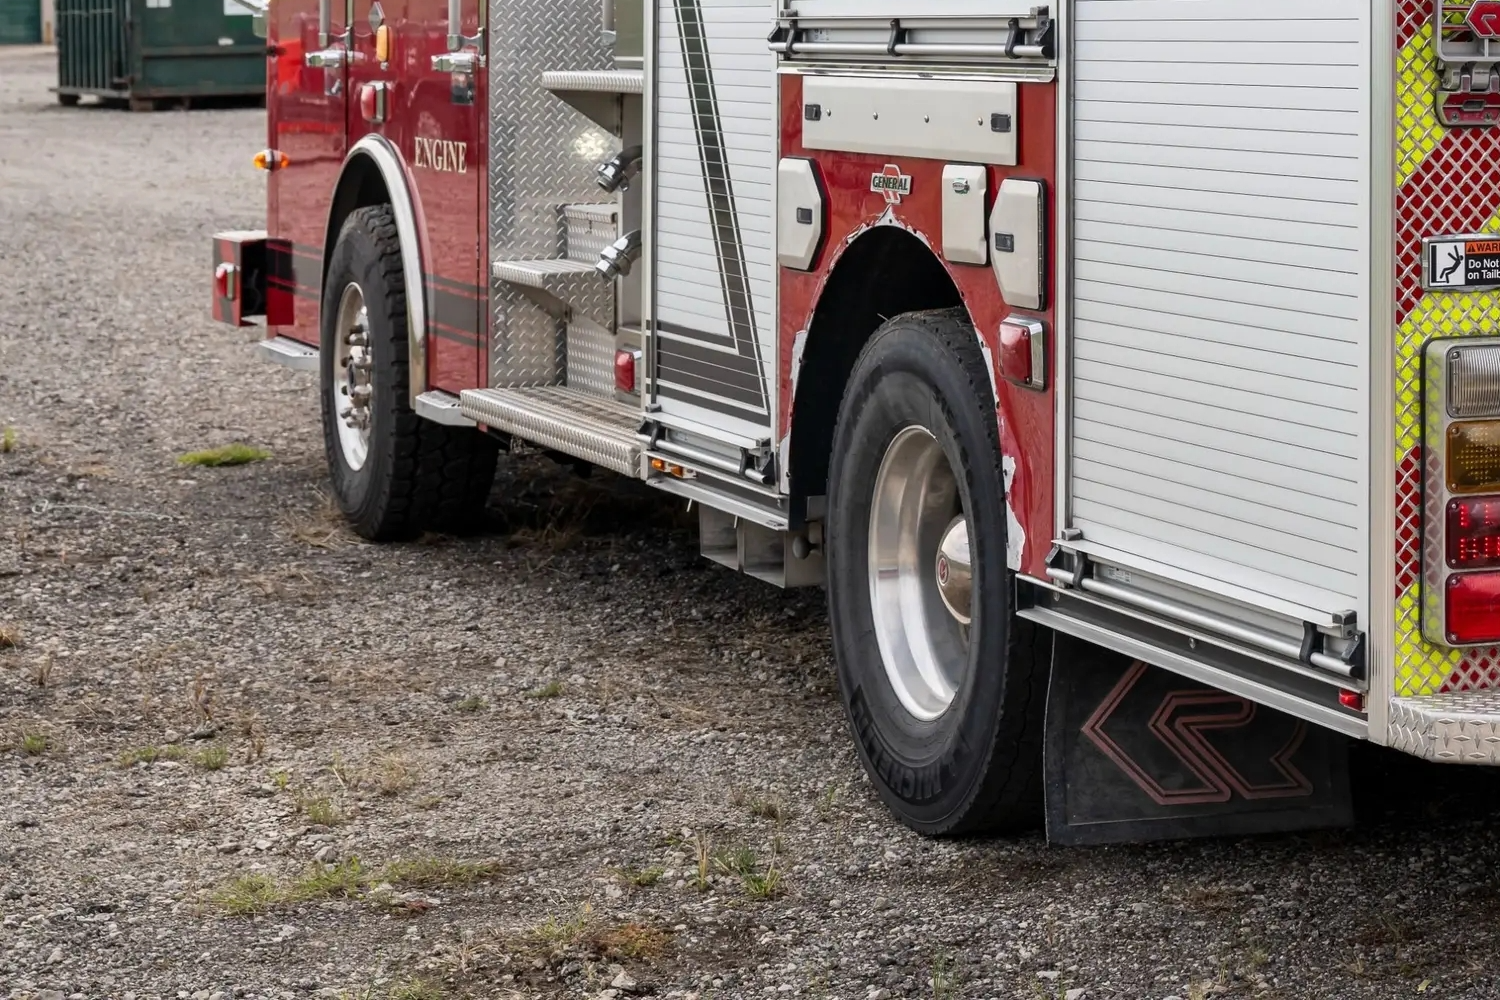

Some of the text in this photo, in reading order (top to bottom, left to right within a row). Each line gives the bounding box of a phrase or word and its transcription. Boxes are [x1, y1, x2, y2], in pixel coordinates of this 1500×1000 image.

[414, 136, 467, 174] ENGINE
[872, 175, 908, 191] GENERAL
[1468, 259, 1481, 268] Do
[1483, 258, 1500, 268] Not
